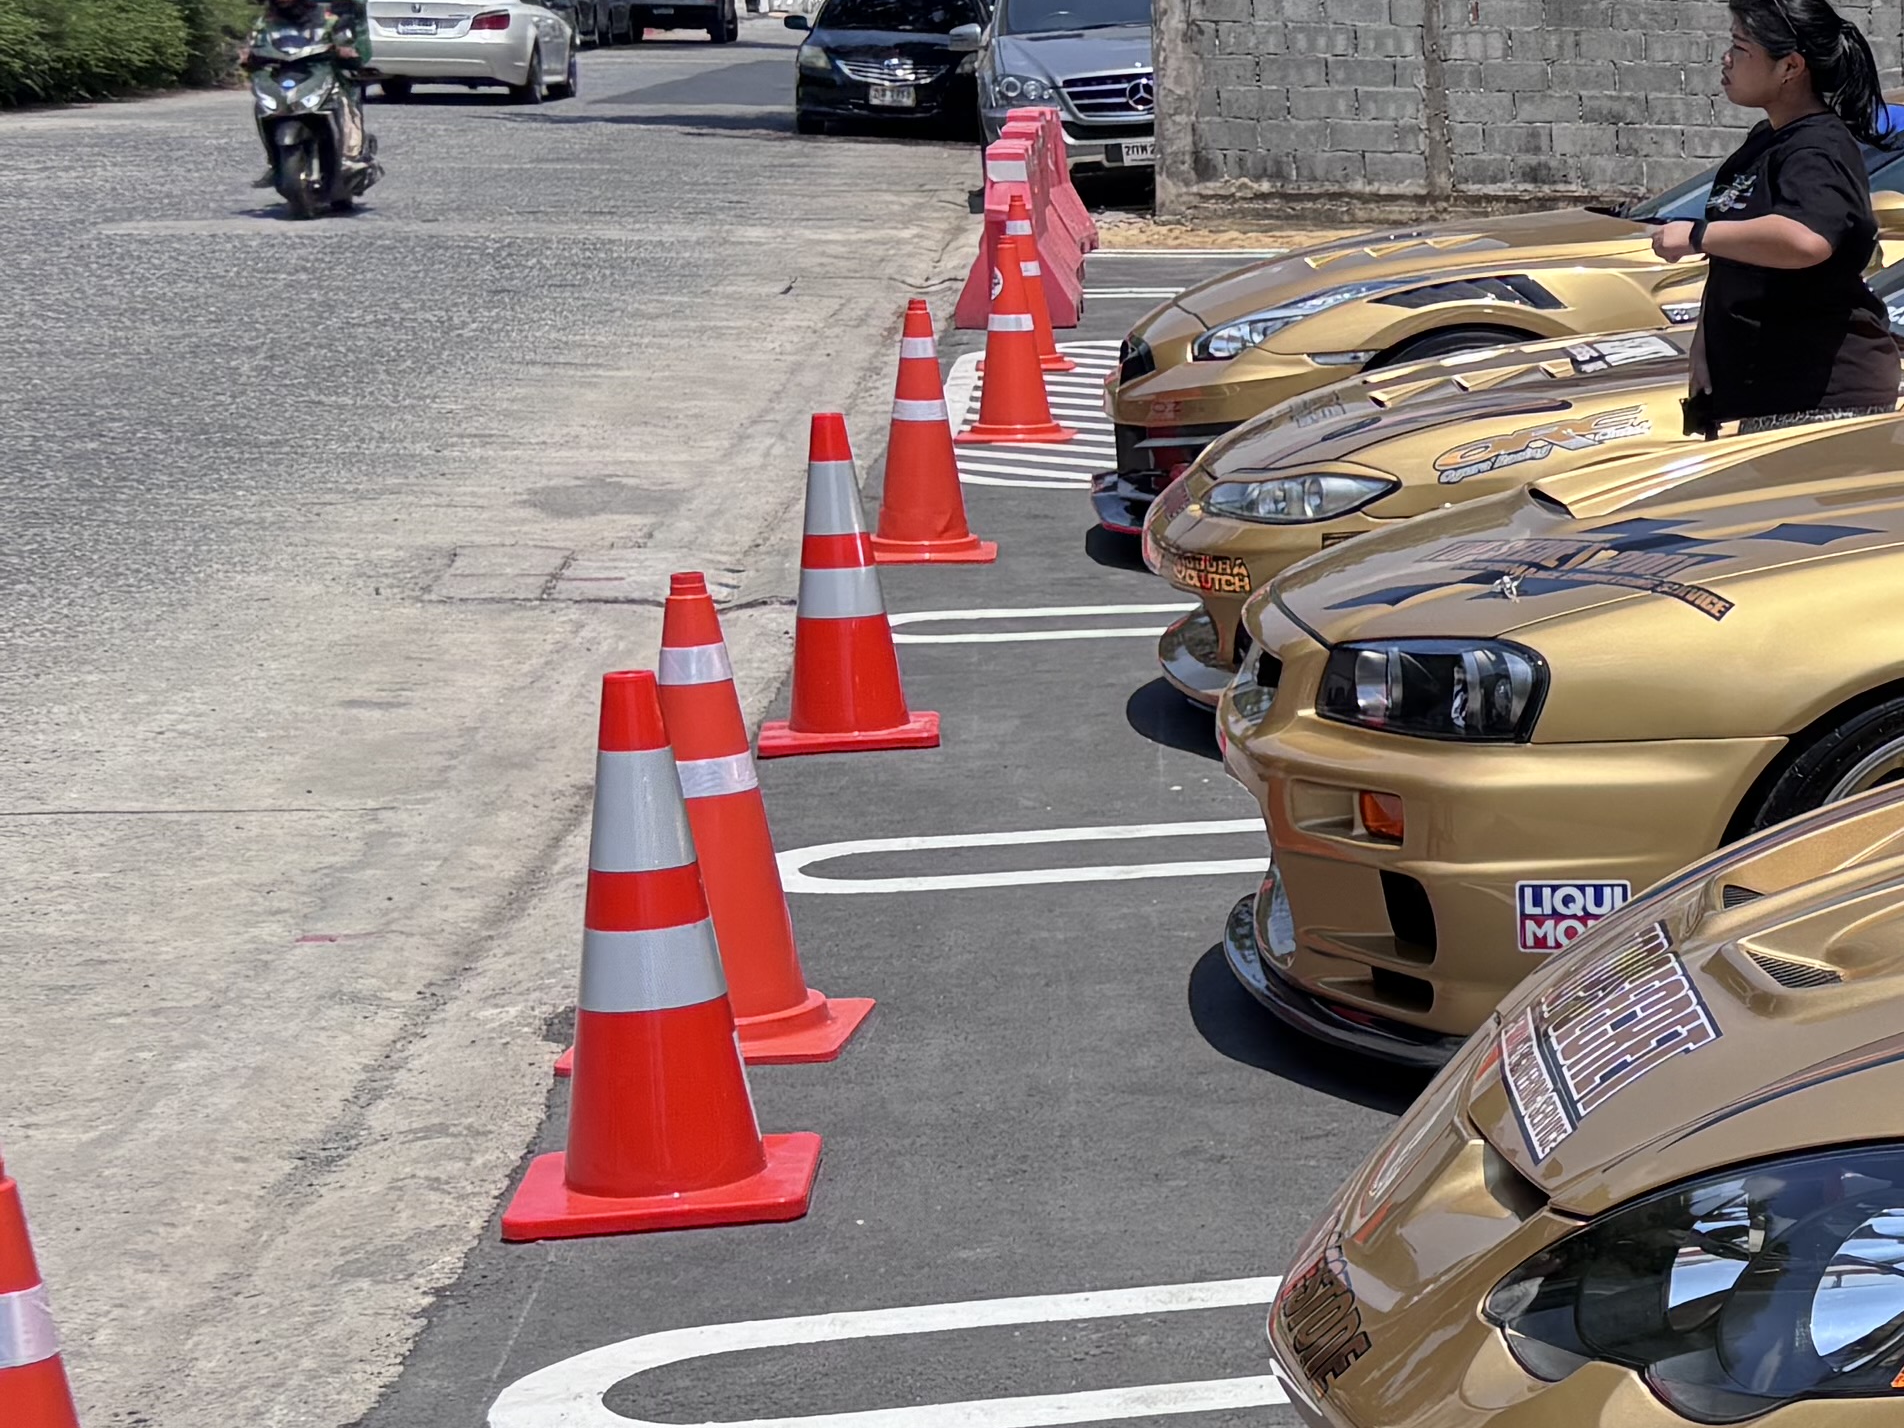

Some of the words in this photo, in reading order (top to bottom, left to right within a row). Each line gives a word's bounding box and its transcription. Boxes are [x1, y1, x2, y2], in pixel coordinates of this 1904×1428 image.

[1523, 885, 1623, 917] LIQUI
[1525, 919, 1600, 948] MO
[1547, 951, 1717, 1118] SECRET
